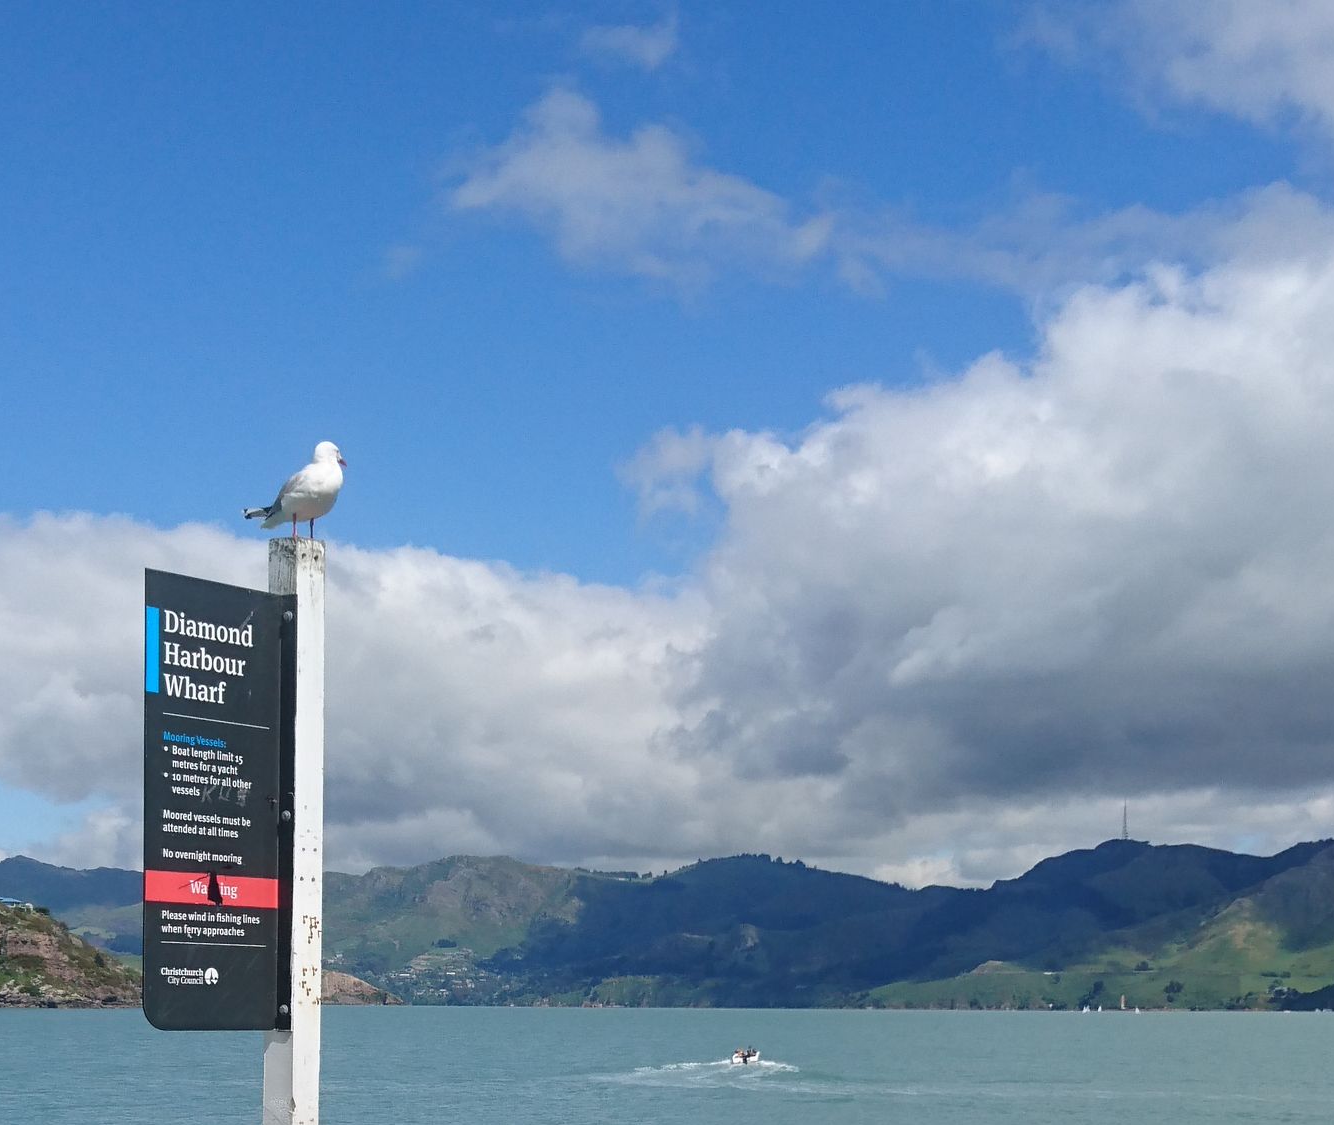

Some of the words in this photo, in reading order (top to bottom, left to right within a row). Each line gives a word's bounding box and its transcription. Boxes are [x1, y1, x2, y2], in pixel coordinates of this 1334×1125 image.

[164, 610, 253, 647] Diamond
[164, 642, 246, 676] Harbour
[164, 673, 226, 704] Wharf
[163, 731, 195, 745] Mooring
[197, 735, 227, 748] Vessels:
[172, 745, 189, 756] Boat
[192, 747, 215, 760] length
[217, 751, 233, 762] limit
[235, 755, 243, 765] 15
[172, 760, 198, 770] metres
[199, 761, 210, 772] for
[217, 765, 238, 776] yacht
[172, 773, 181, 781] 10
[183, 775, 209, 784] metres
[210, 776, 220, 786] for
[222, 777, 231, 787] all
[233, 780, 252, 789] other
[172, 786, 200, 796] vessels
[163, 809, 192, 821] Moored
[194, 814, 221, 824] vessels
[223, 816, 240, 826] must
[241, 817, 251, 827] be
[163, 824, 197, 835] attended
[199, 826, 206, 836] at
[208, 826, 217, 836] all
[218, 828, 238, 838] times
[163, 848, 173, 858] No
[175, 850, 211, 862] overnight
[212, 854, 242, 864] mooring
[190, 880, 238, 899] Waing
[162, 910, 186, 920] Please
[188, 912, 206, 922] wind
[208, 913, 215, 922] in
[217, 912, 242, 924] fishing
[243, 914, 260, 924] lines
[162, 924, 182, 934] when
[184, 925, 201, 936] ferry
[203, 927, 245, 937] approaches
[161, 967, 203, 976] Christchurch
[168, 976, 180, 985] City
